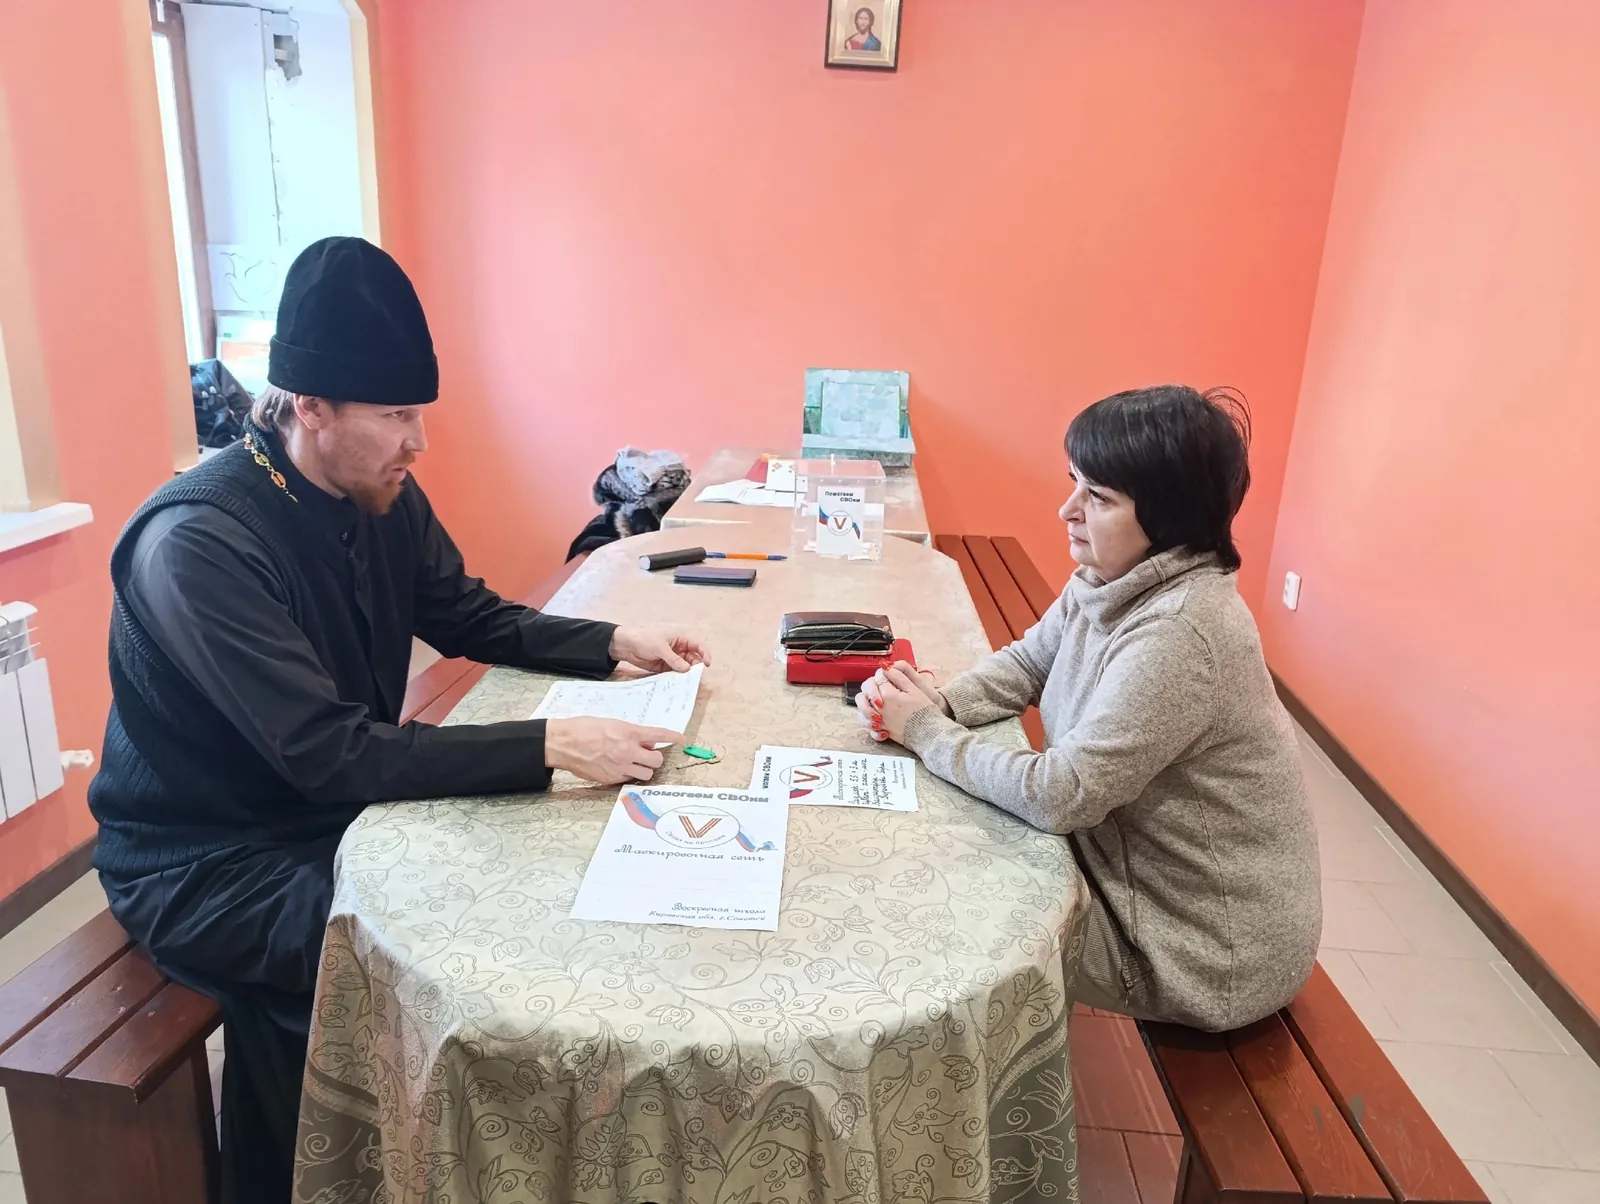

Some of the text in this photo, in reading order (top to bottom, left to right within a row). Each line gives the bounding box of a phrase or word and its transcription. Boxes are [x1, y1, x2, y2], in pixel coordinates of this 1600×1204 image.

[834, 517, 847, 529] V
[793, 770, 820, 784] V
[641, 789, 769, 803] Помогаем СВОим
[678, 815, 722, 838] V
[614, 844, 724, 859] Маскировочная
[671, 902, 729, 914] Воскресная
